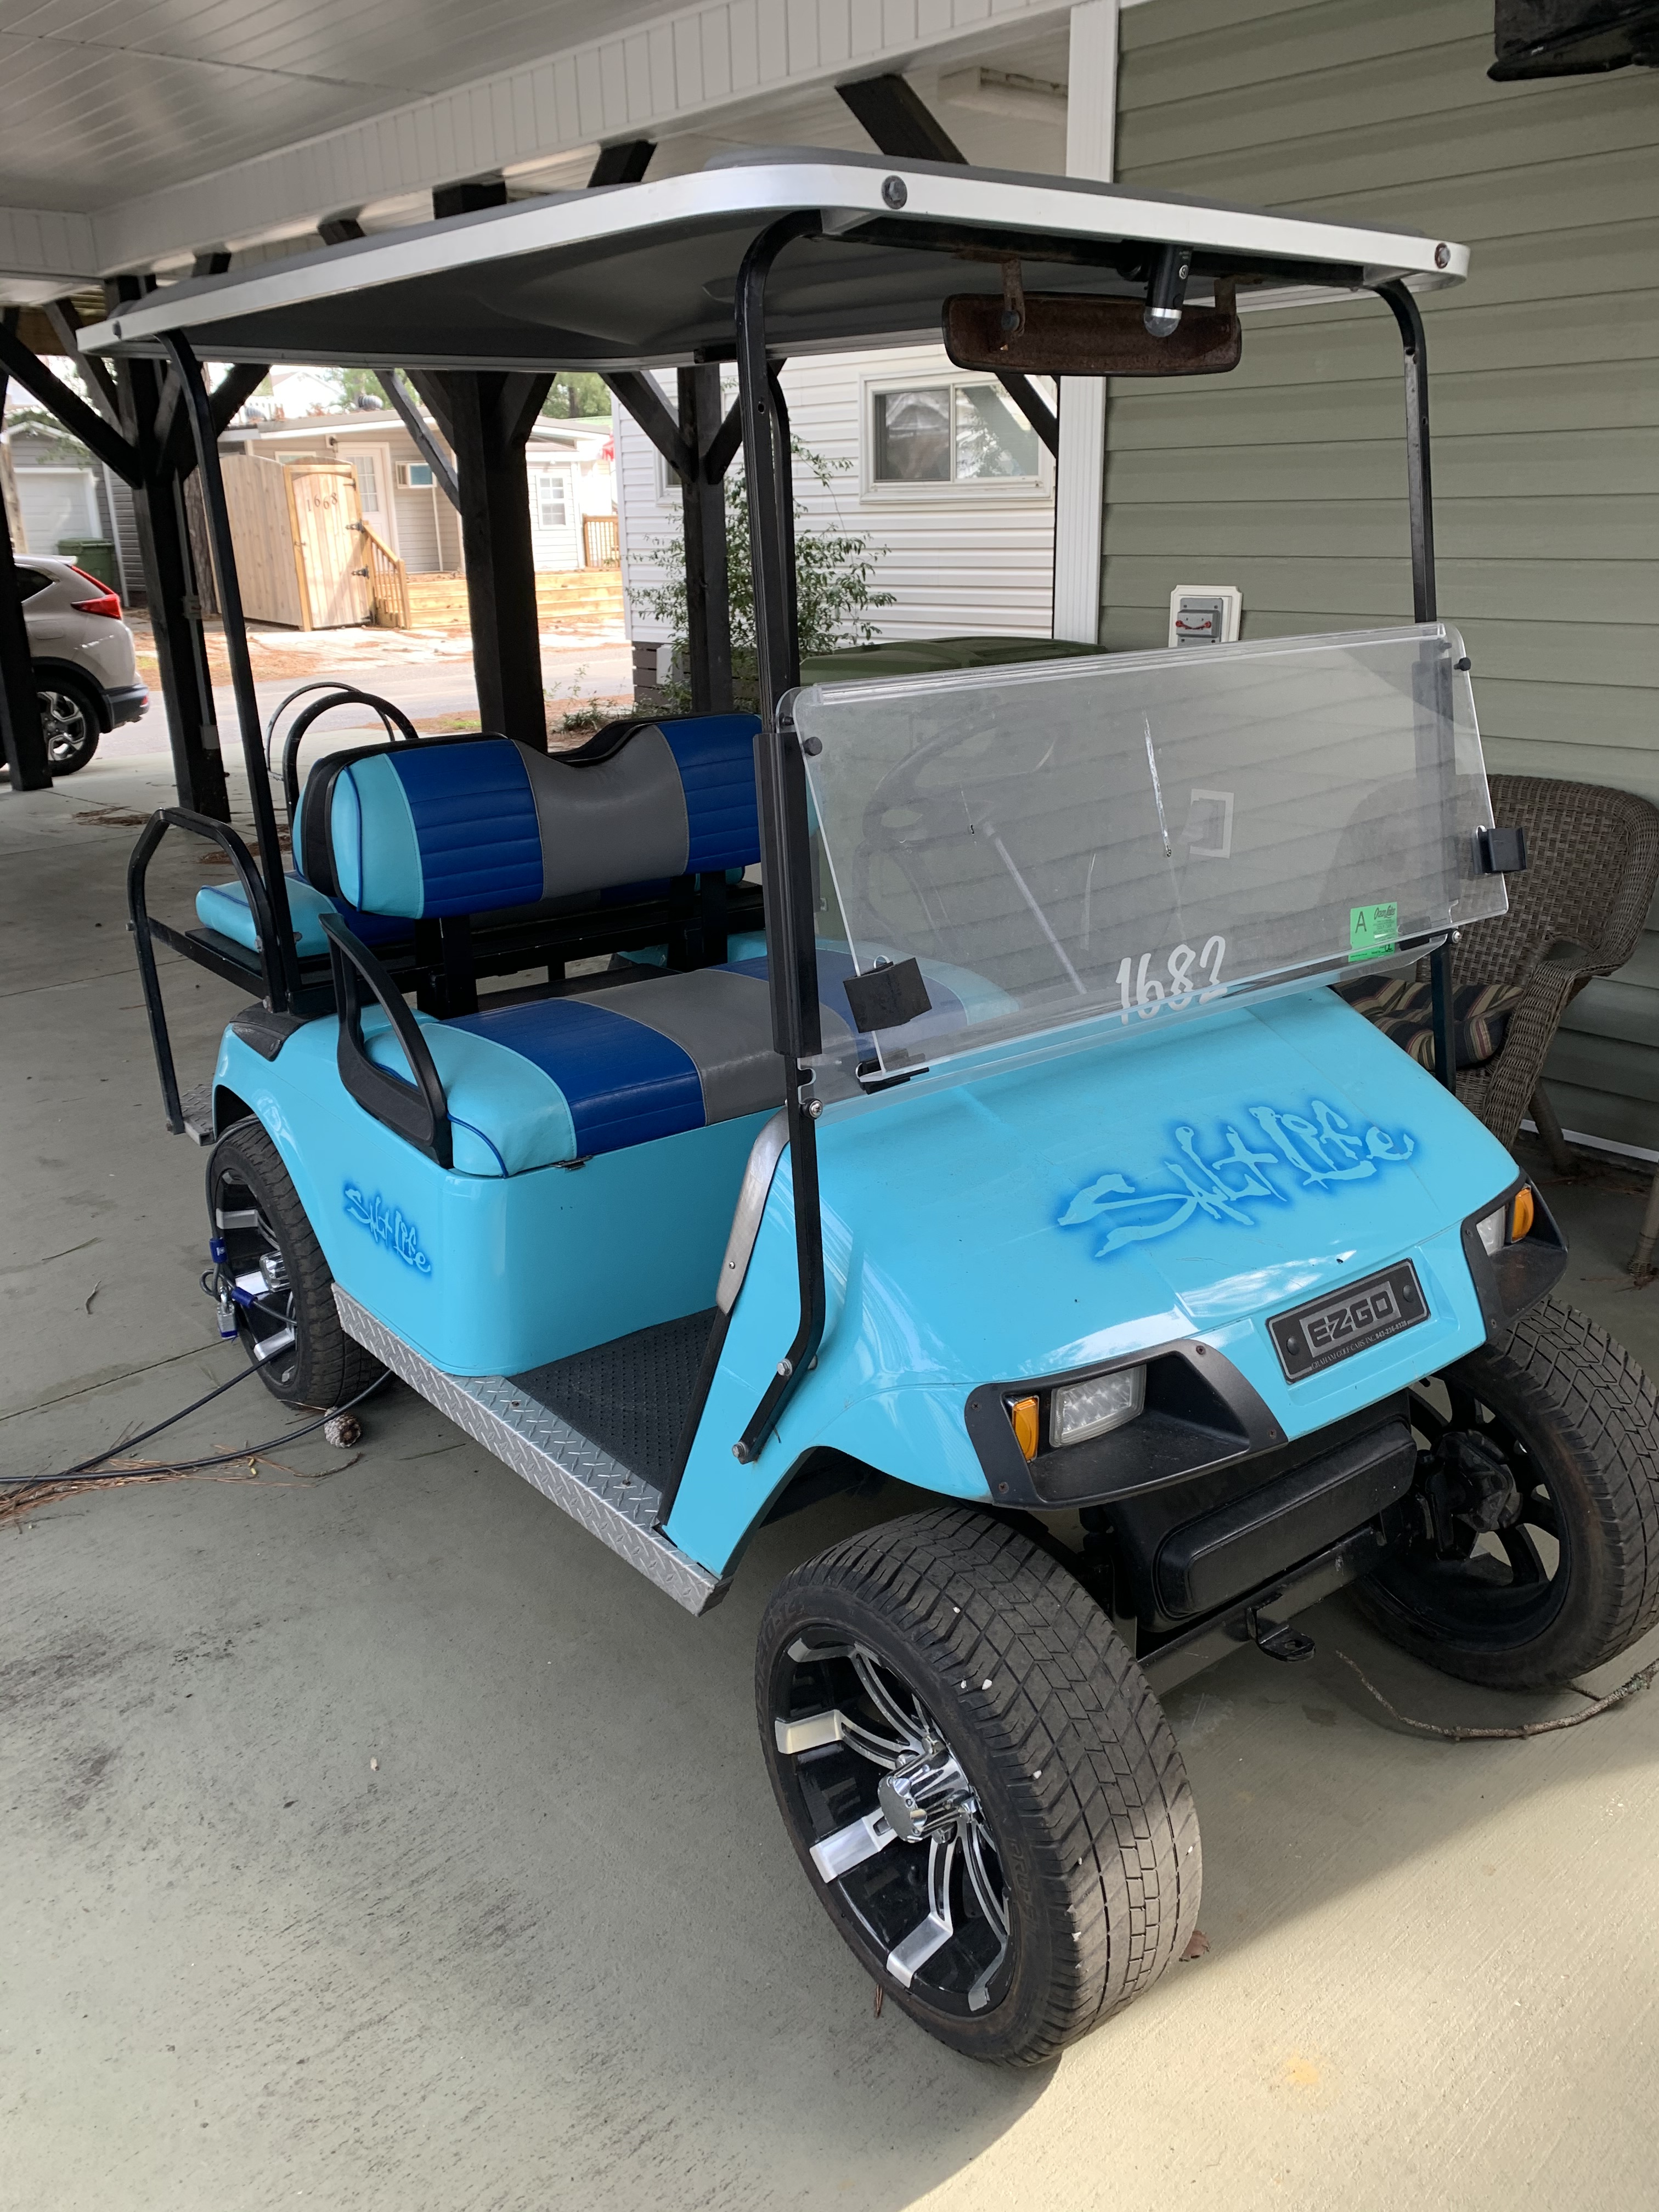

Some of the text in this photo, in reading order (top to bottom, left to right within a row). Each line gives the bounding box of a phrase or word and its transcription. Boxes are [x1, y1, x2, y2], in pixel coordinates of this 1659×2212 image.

[307, 492, 338, 511] 1668
[1355, 911, 1367, 934] A
[1115, 935, 1228, 1025] 1682
[1311, 1353, 1337, 1369] GRAHAM
[1336, 1346, 1350, 1358] GOLF
